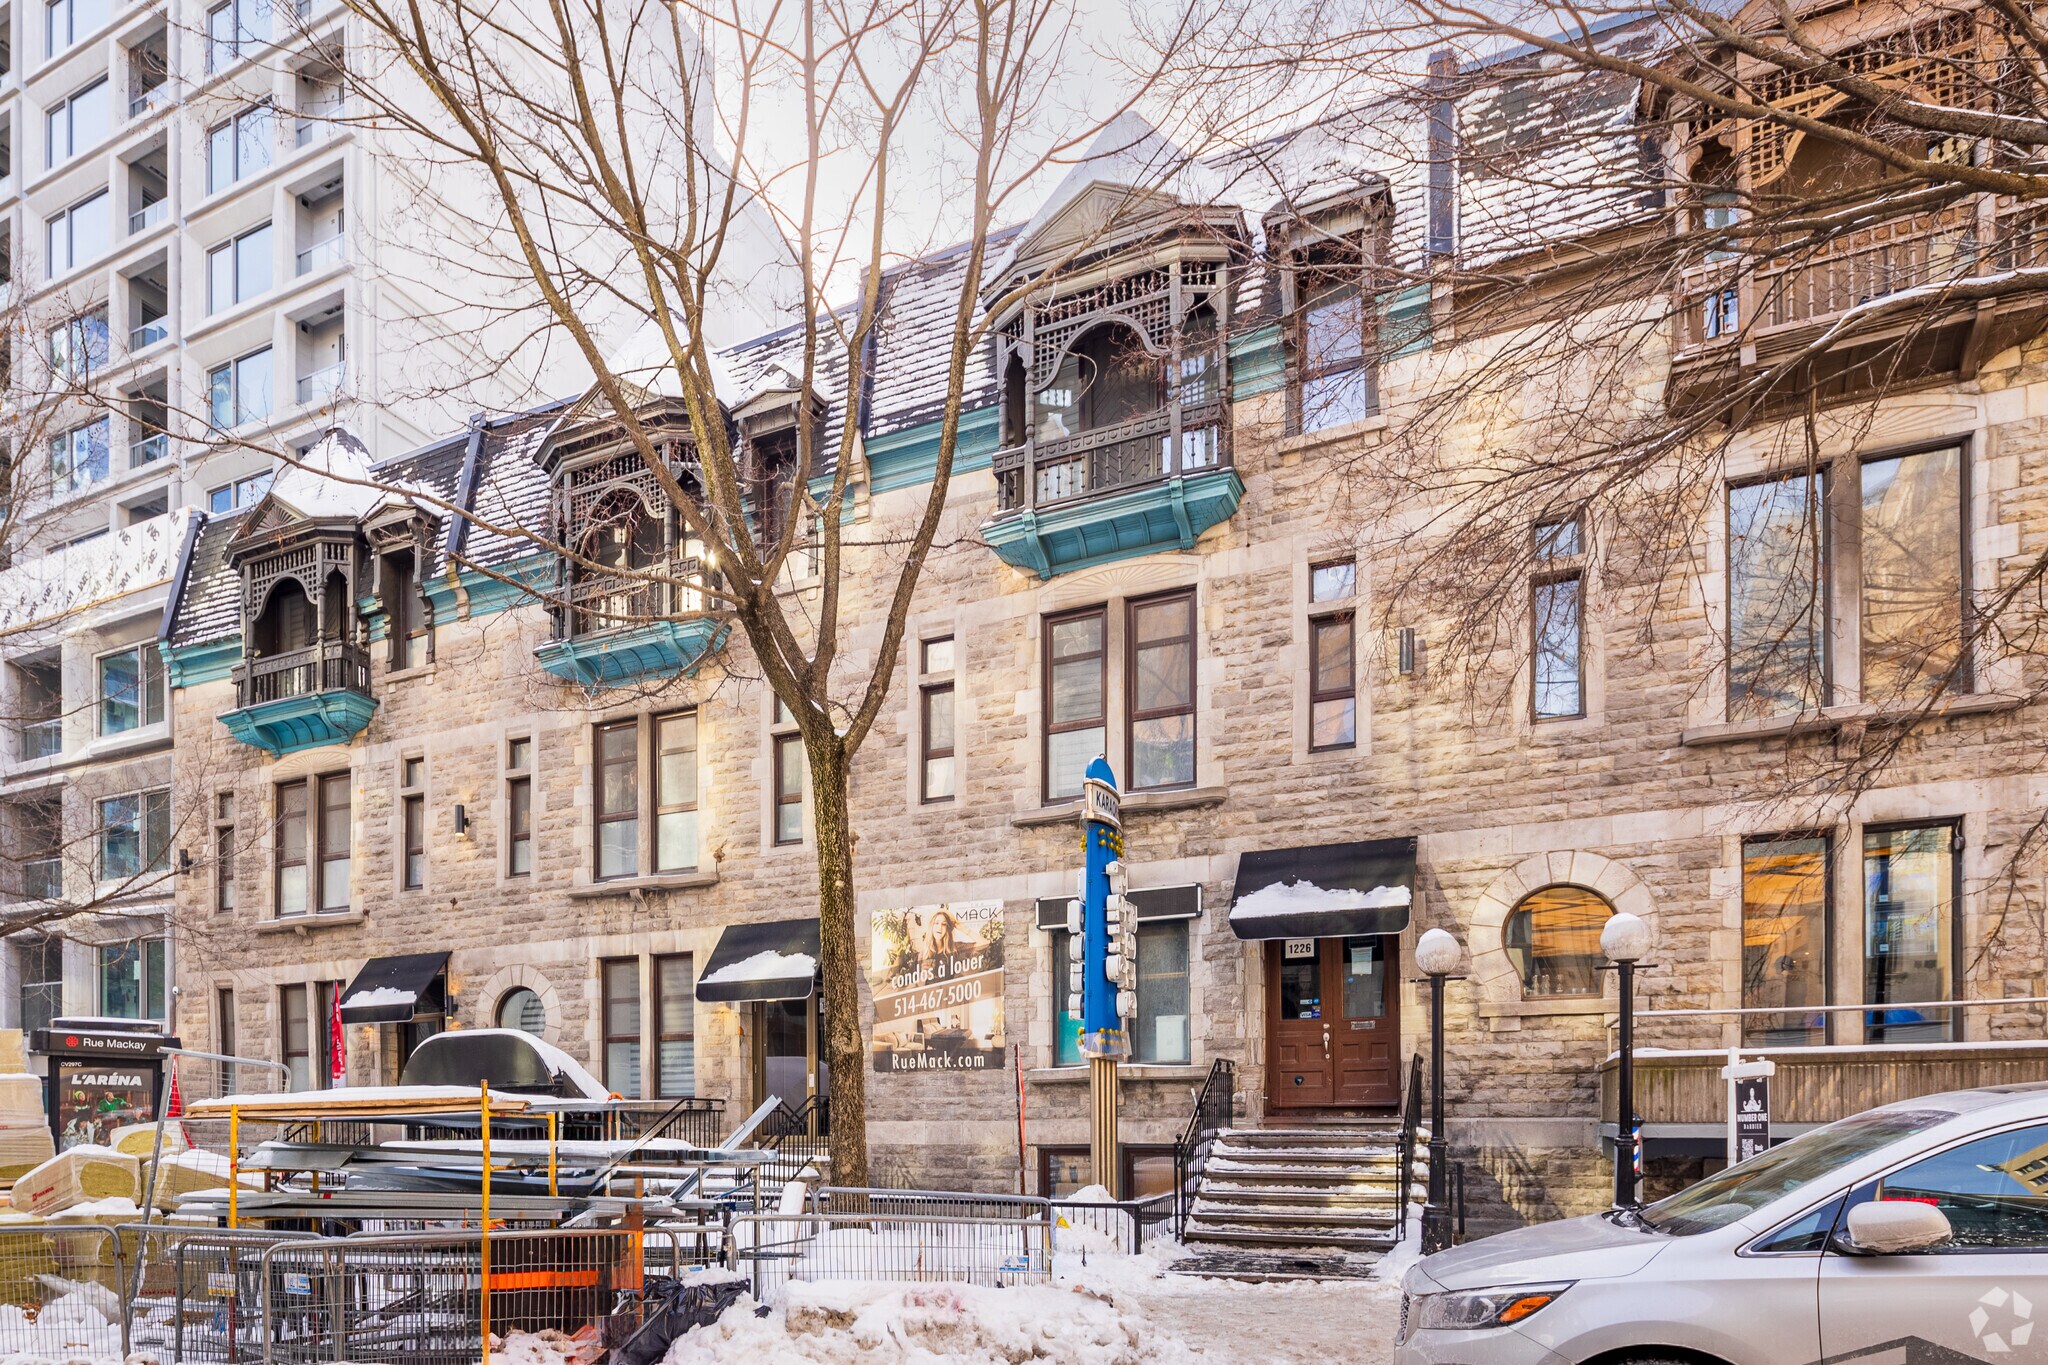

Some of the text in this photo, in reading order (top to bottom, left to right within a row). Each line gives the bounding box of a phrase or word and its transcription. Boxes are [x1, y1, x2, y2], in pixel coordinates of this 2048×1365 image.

[955, 906, 998, 920] MACK
[1289, 944, 1311, 954] 1226
[891, 955, 985, 989] condos à louer
[894, 979, 982, 1017] 514-467-5000
[83, 1037, 147, 1051] Rue Mackay
[892, 1051, 985, 1070] RueMack.com
[71, 1072, 142, 1086] L'ARÉNA
[1737, 1112, 1767, 1122] NUMBER ONE
